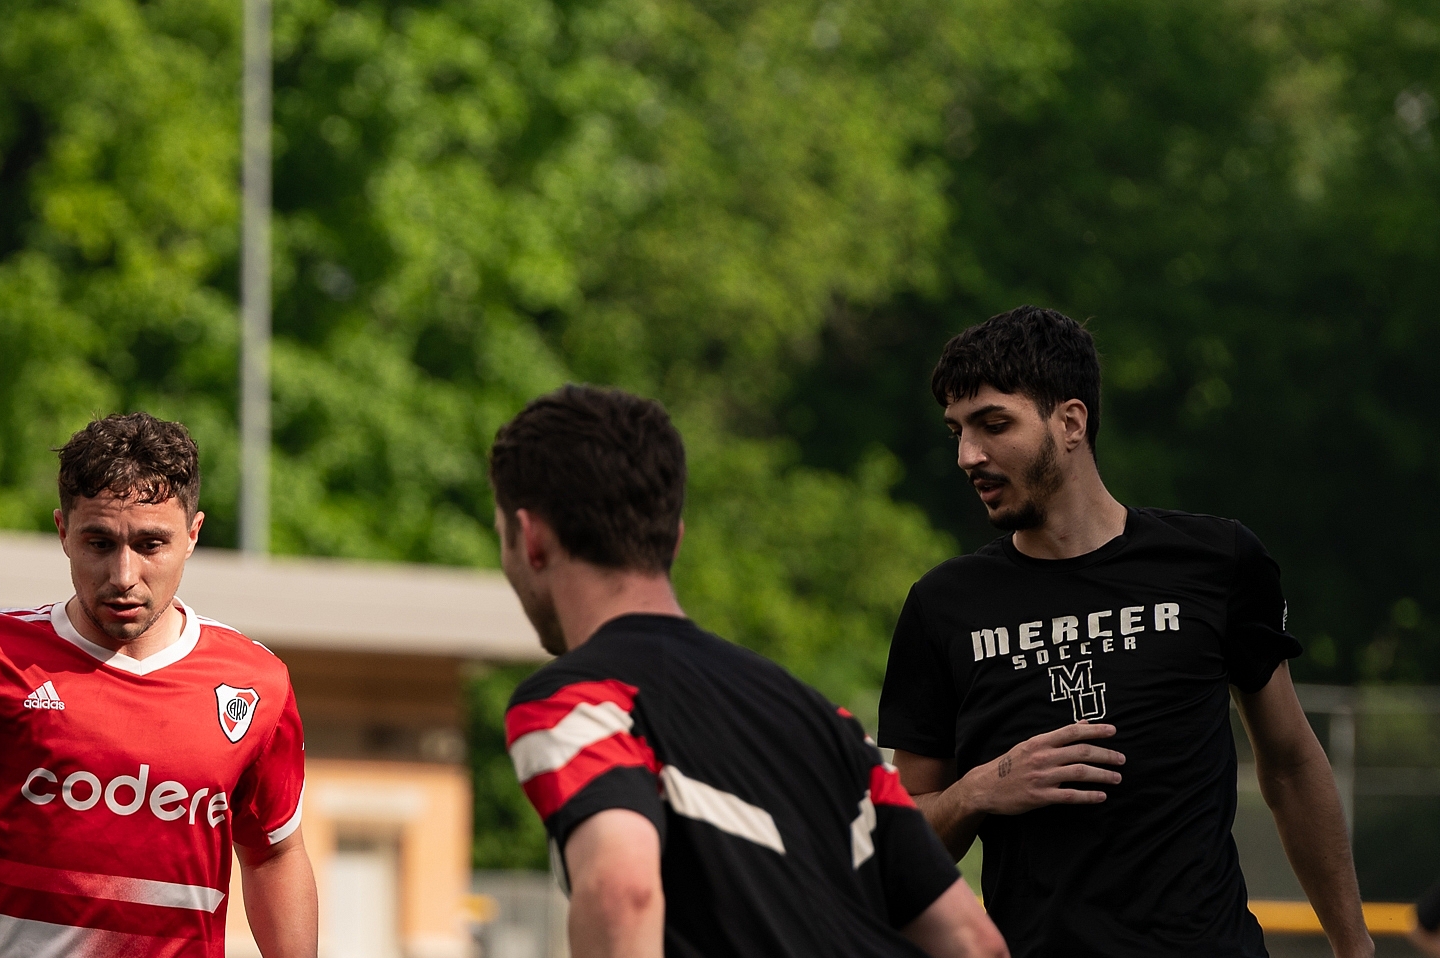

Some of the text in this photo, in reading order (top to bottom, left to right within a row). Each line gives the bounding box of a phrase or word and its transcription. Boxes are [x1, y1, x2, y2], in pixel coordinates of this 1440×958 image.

[971, 602, 1180, 662] MERCER
[1012, 636, 1137, 670] SOCCER
[23, 698, 66, 711] adidas
[1048, 659, 1106, 723] MU
[21, 763, 229, 829] codere
